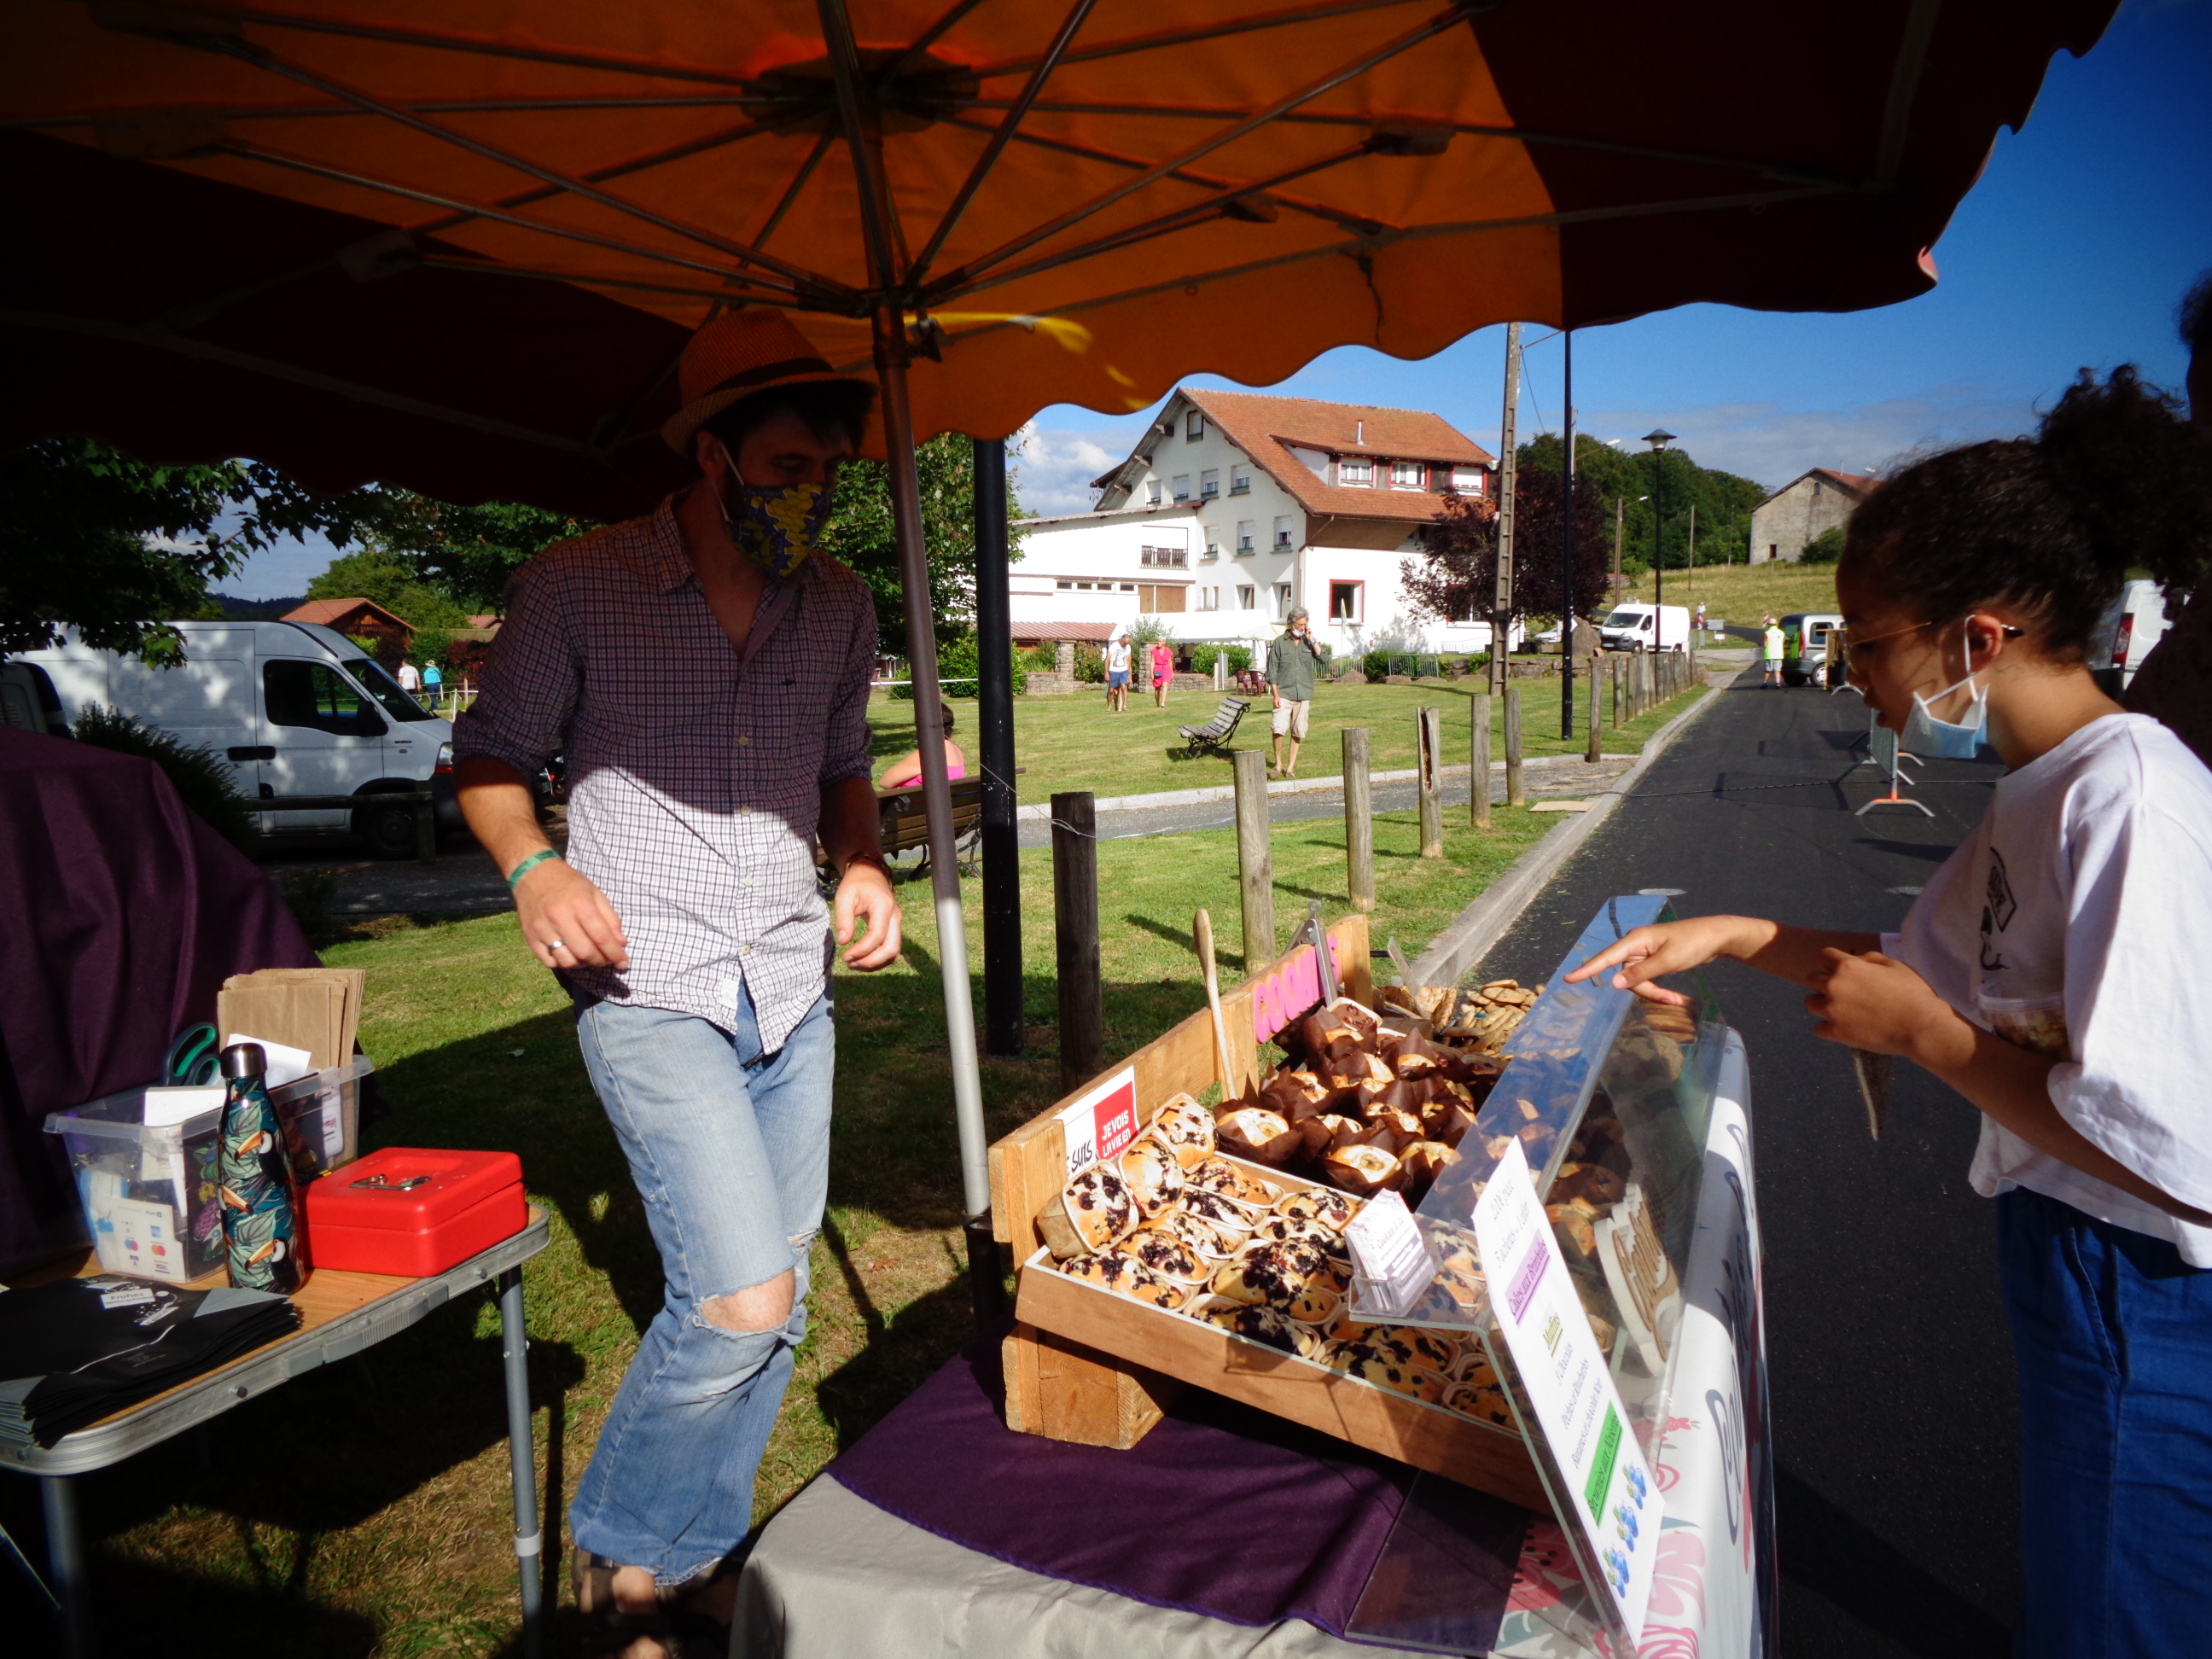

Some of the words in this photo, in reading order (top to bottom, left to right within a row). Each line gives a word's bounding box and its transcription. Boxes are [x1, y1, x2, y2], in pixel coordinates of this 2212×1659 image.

[1103, 1123, 1113, 1140] JE
[1111, 1109, 1129, 1133] VOIS
[1072, 1138, 1092, 1173] SUIS
[1103, 1142, 1111, 1157] LA
[1111, 1135, 1122, 1150] VIE
[110, 1291, 144, 1301] Frohes
[1508, 1288, 1525, 1316] Cakes
